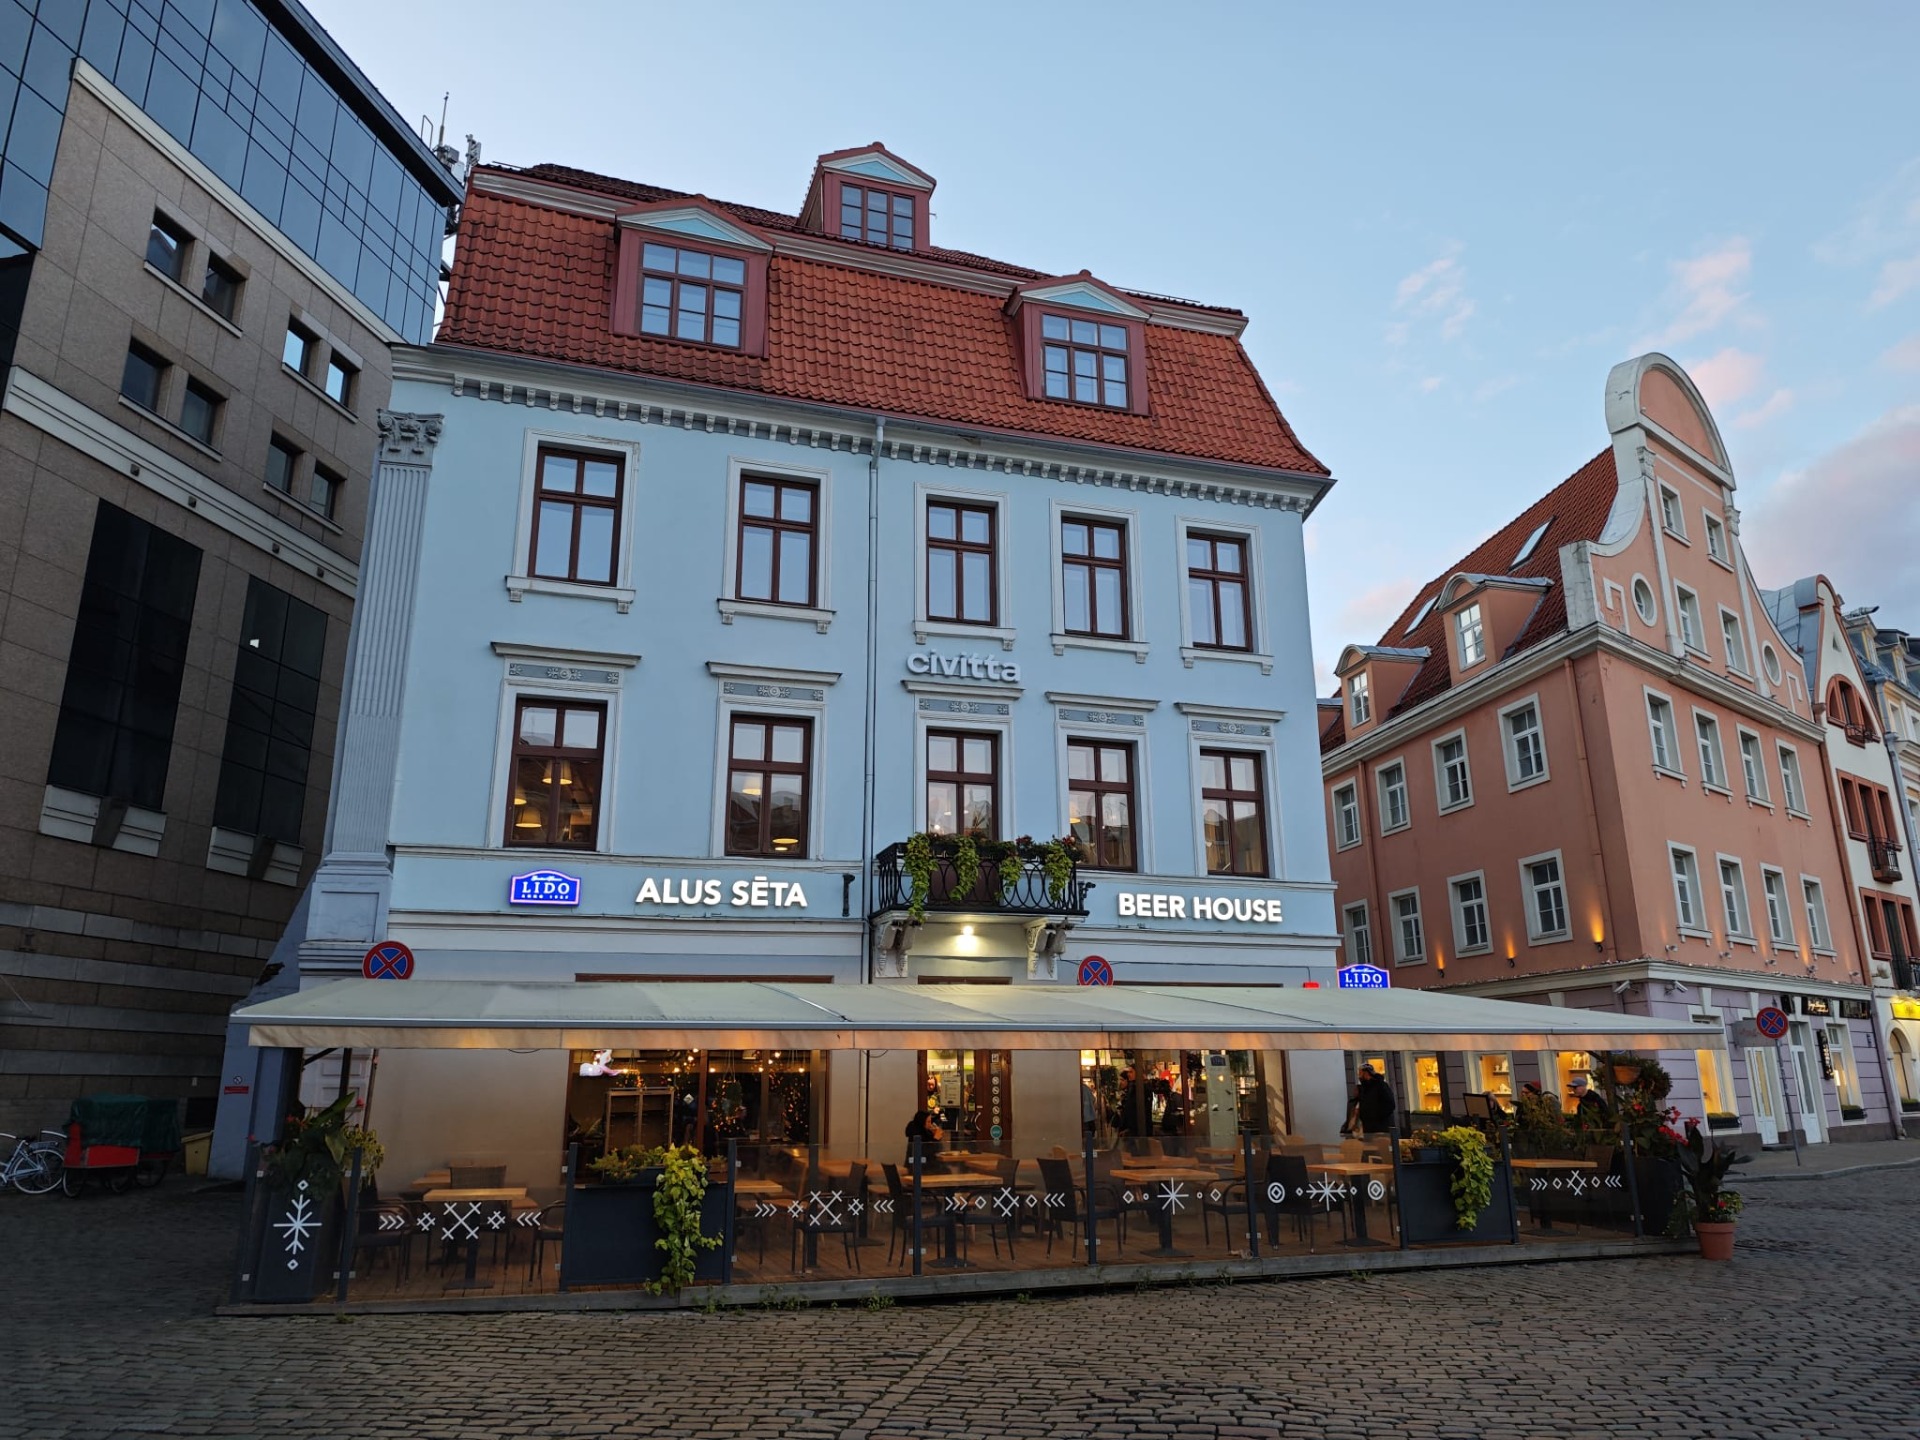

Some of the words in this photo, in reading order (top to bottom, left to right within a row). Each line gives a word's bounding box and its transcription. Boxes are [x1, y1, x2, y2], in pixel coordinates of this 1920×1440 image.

[907, 649, 1021, 683] civitta
[521, 881, 570, 895] LIDO
[635, 877, 722, 906] ALUS
[731, 875, 808, 908] SĒTA
[1117, 892, 1187, 919] BEER
[1192, 895, 1283, 924] HOUSE
[1344, 973, 1383, 984] LIDO
